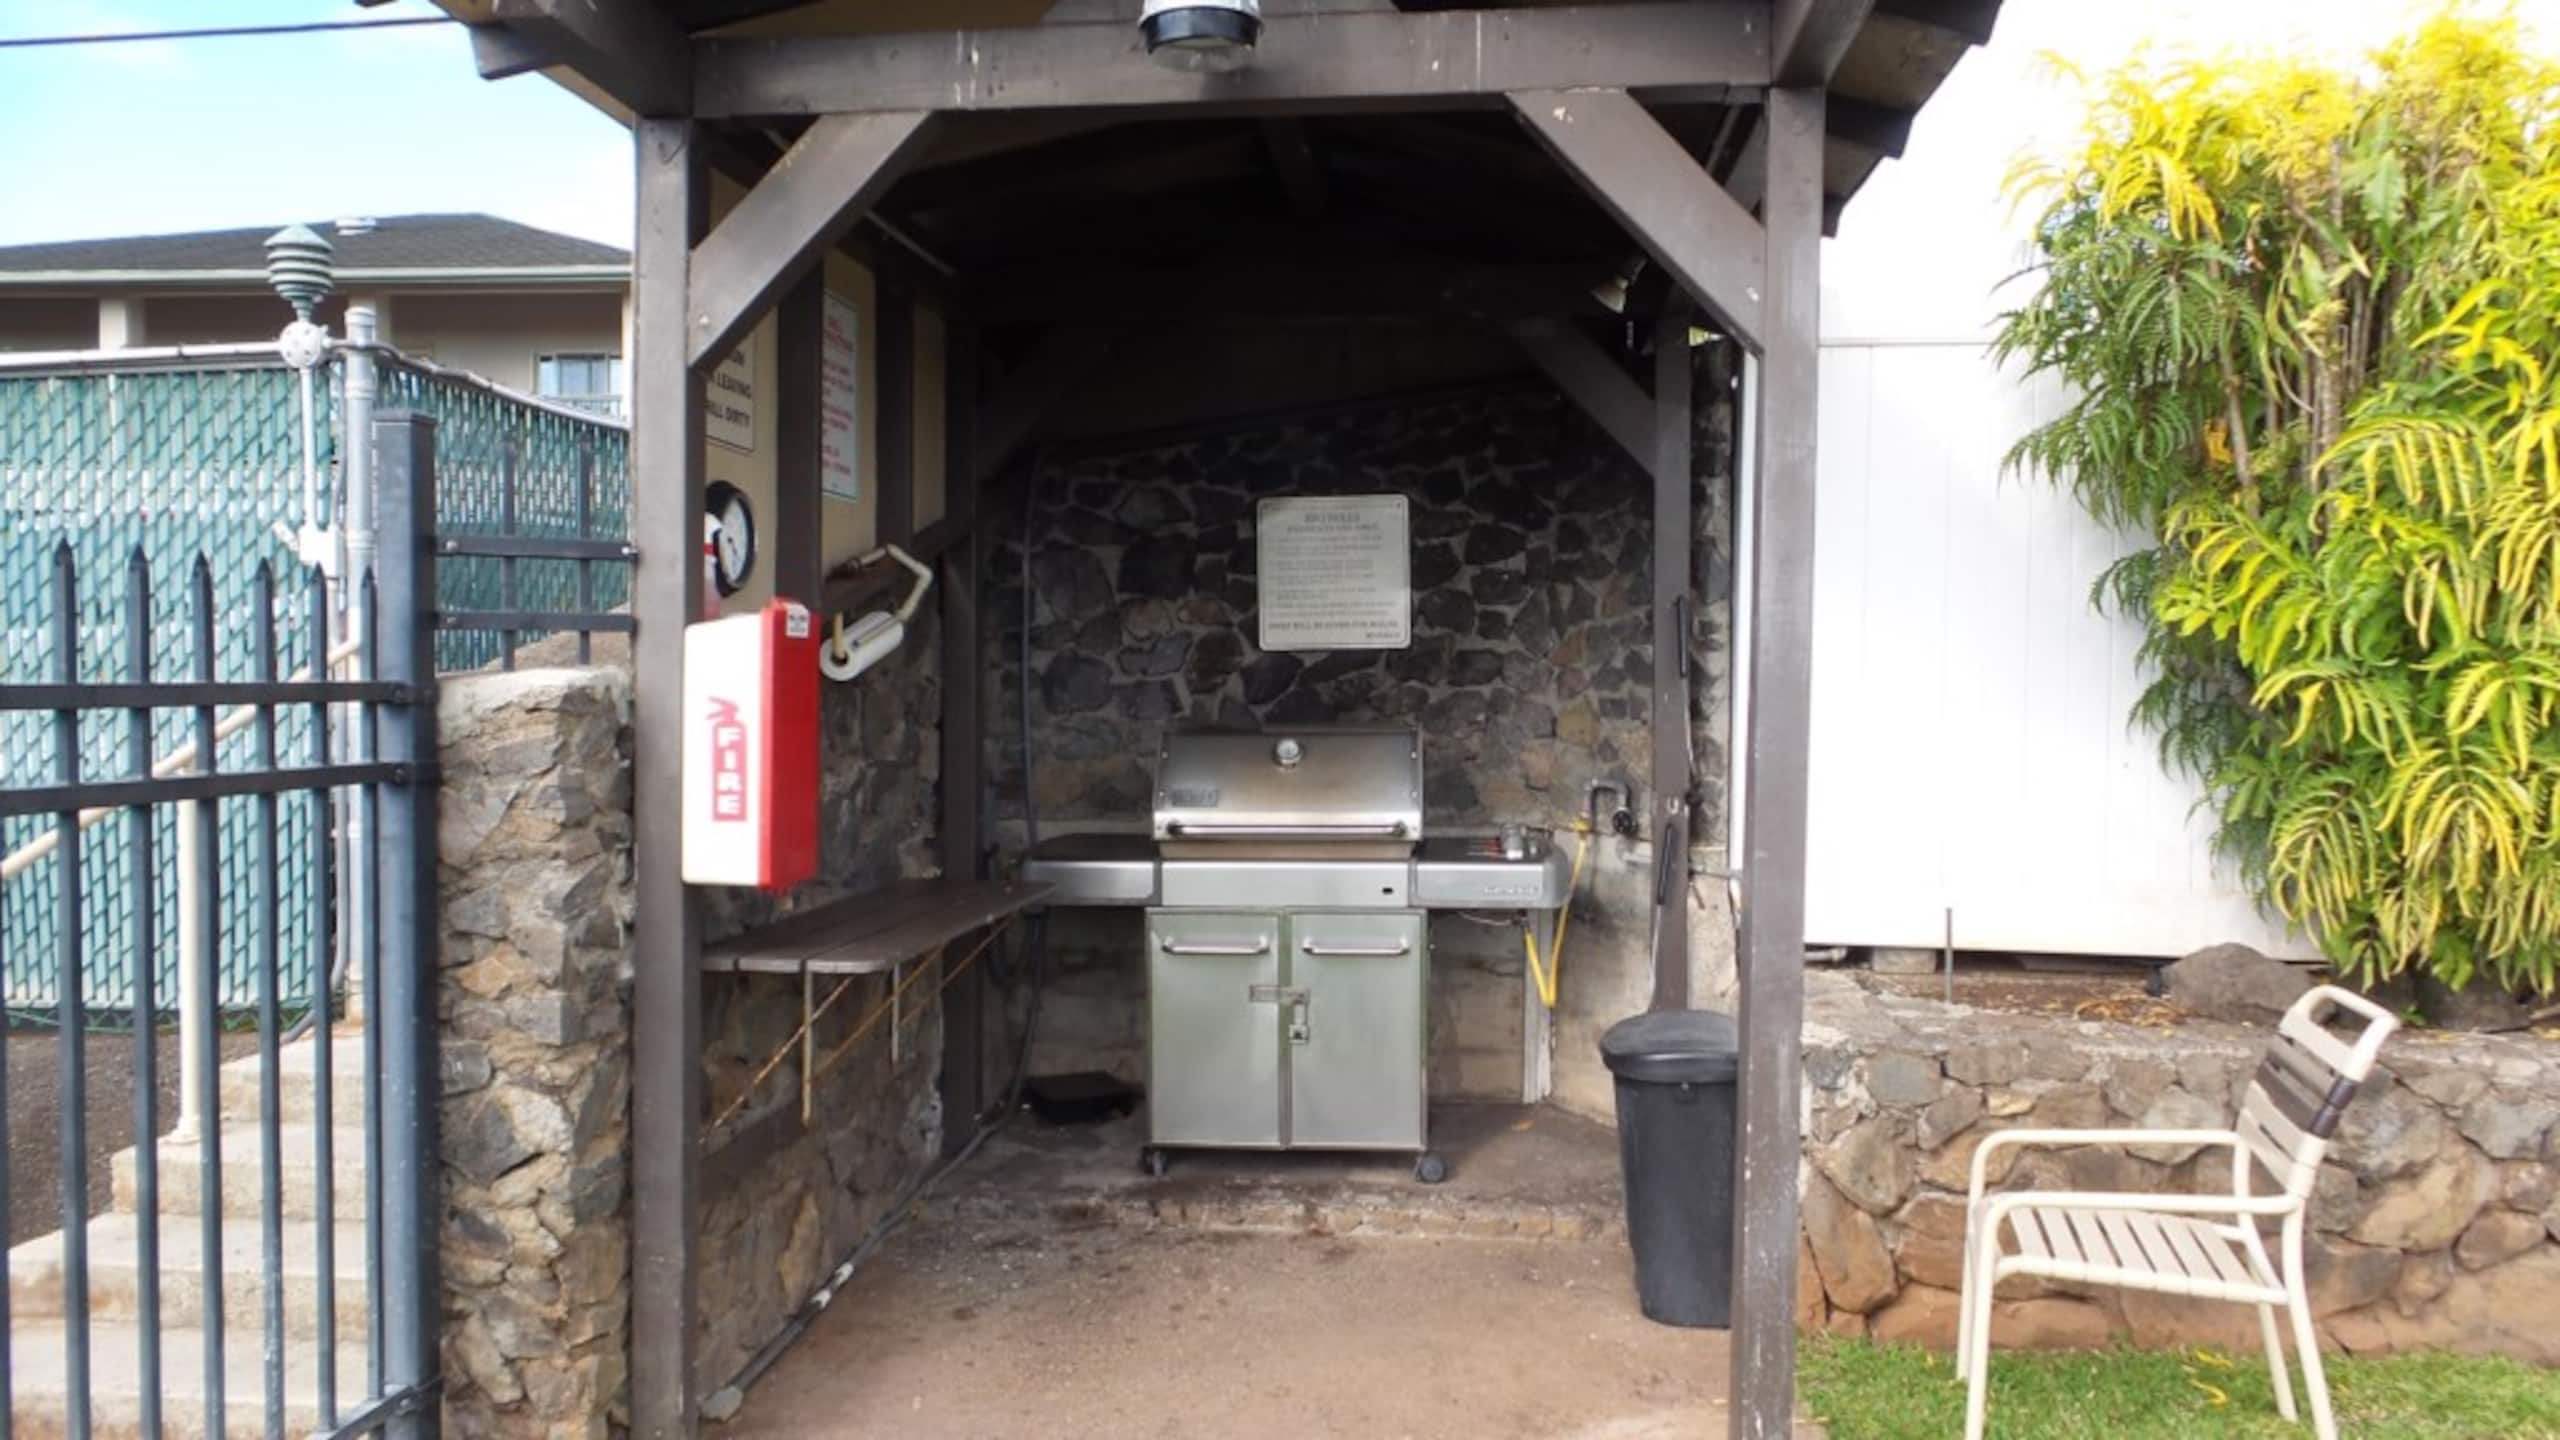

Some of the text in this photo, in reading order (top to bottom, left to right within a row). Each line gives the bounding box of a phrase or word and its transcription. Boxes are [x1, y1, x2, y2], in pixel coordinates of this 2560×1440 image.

[717, 372, 752, 401] LEAVING
[725, 406, 751, 429] DIRTY
[717, 726, 742, 816] FIRE
